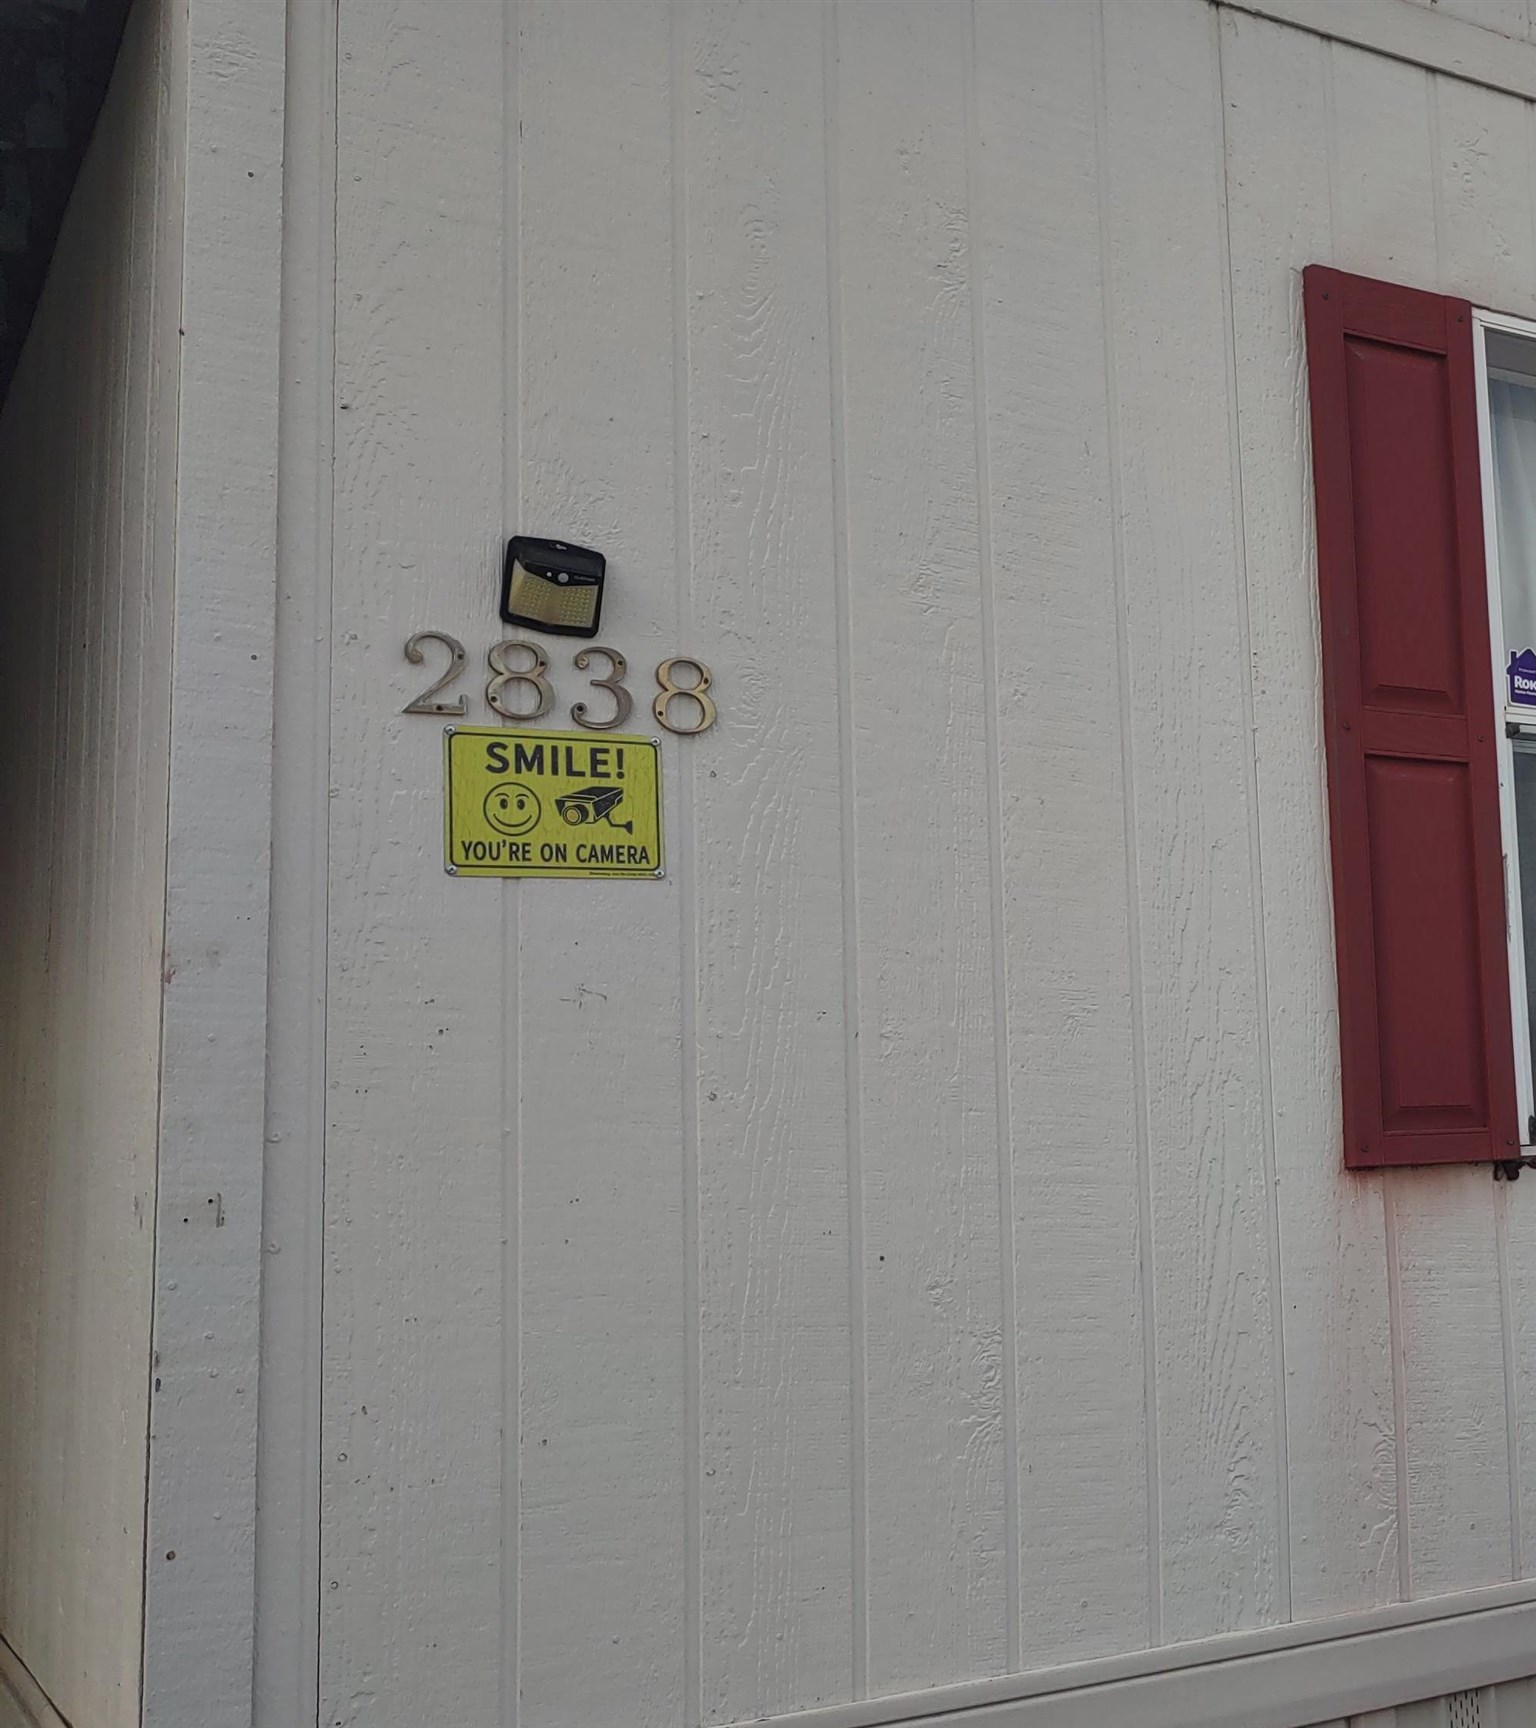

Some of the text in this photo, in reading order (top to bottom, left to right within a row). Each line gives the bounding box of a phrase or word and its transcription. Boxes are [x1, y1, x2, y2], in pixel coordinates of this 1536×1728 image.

[401, 630, 718, 735] 2838
[485, 741, 626, 780] SMILE!
[461, 839, 650, 865] YOU'RE ON CAMERA
